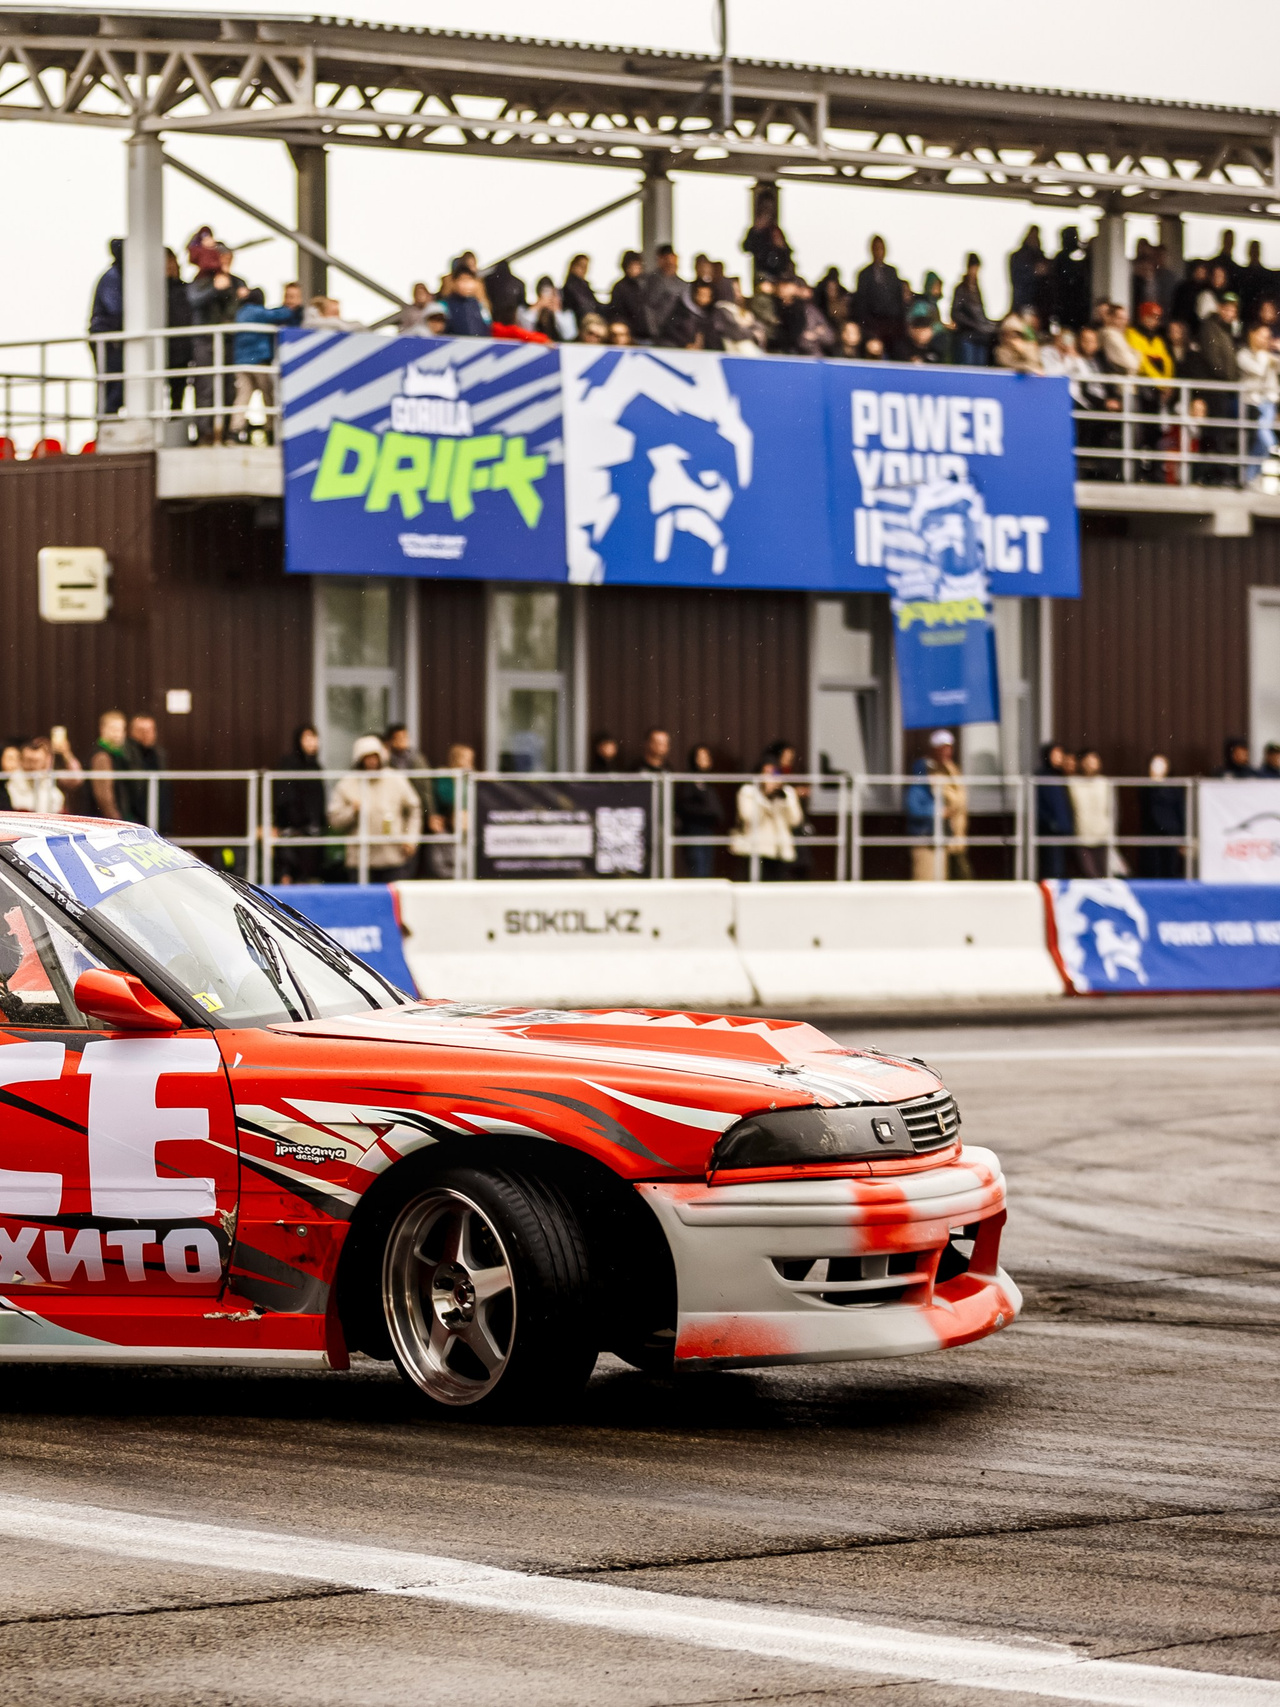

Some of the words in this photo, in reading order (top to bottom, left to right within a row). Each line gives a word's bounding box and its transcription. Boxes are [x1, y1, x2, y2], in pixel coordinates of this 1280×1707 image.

[851, 389, 1005, 456] POWER
[310, 420, 548, 529] DRIFT
[295, 1153, 325, 1163] design
